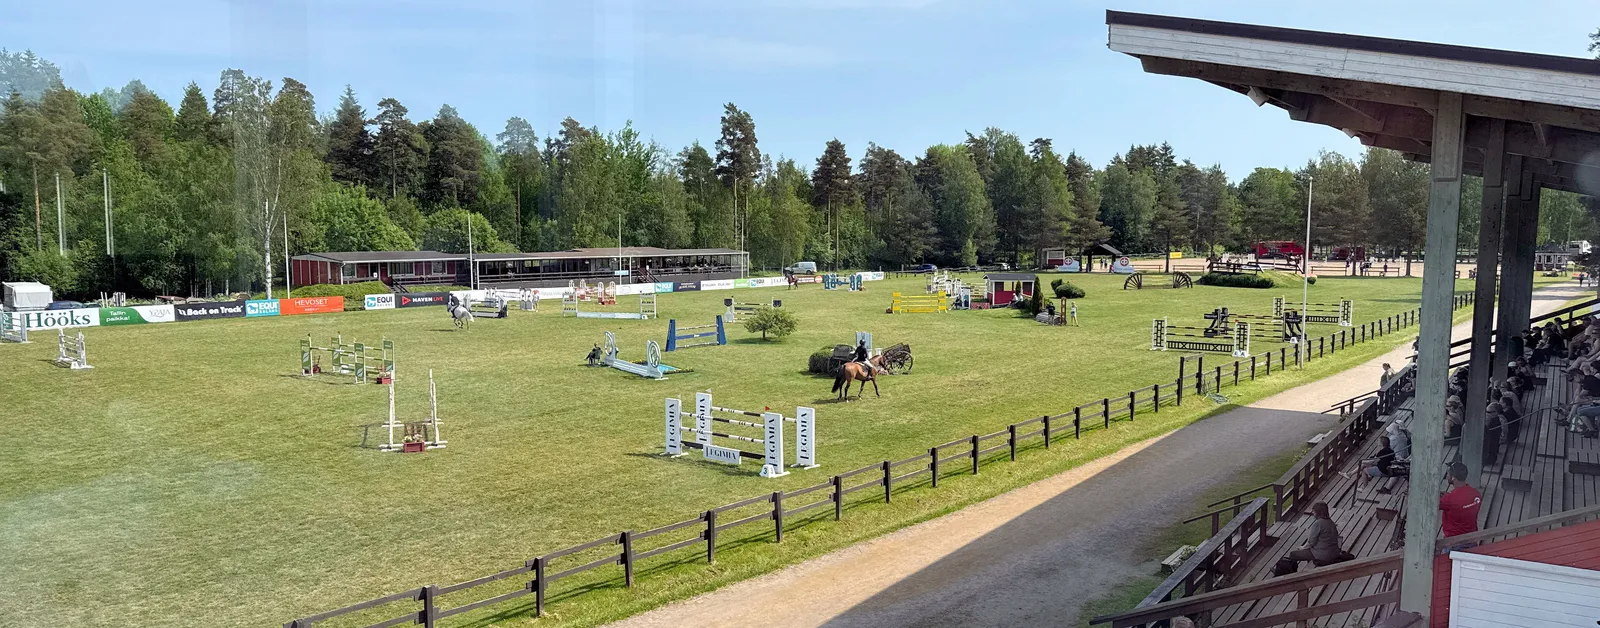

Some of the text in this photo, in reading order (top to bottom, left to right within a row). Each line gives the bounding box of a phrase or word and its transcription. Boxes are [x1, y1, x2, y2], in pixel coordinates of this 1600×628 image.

[25, 310, 91, 328] Hööks
[669, 403, 677, 448] LEGIMIA
[699, 398, 707, 442] LGIMIA
[800, 412, 809, 460] LEGIMIA
[706, 446, 736, 460] LEGIMIA
[768, 418, 778, 467] LEGIMIA
